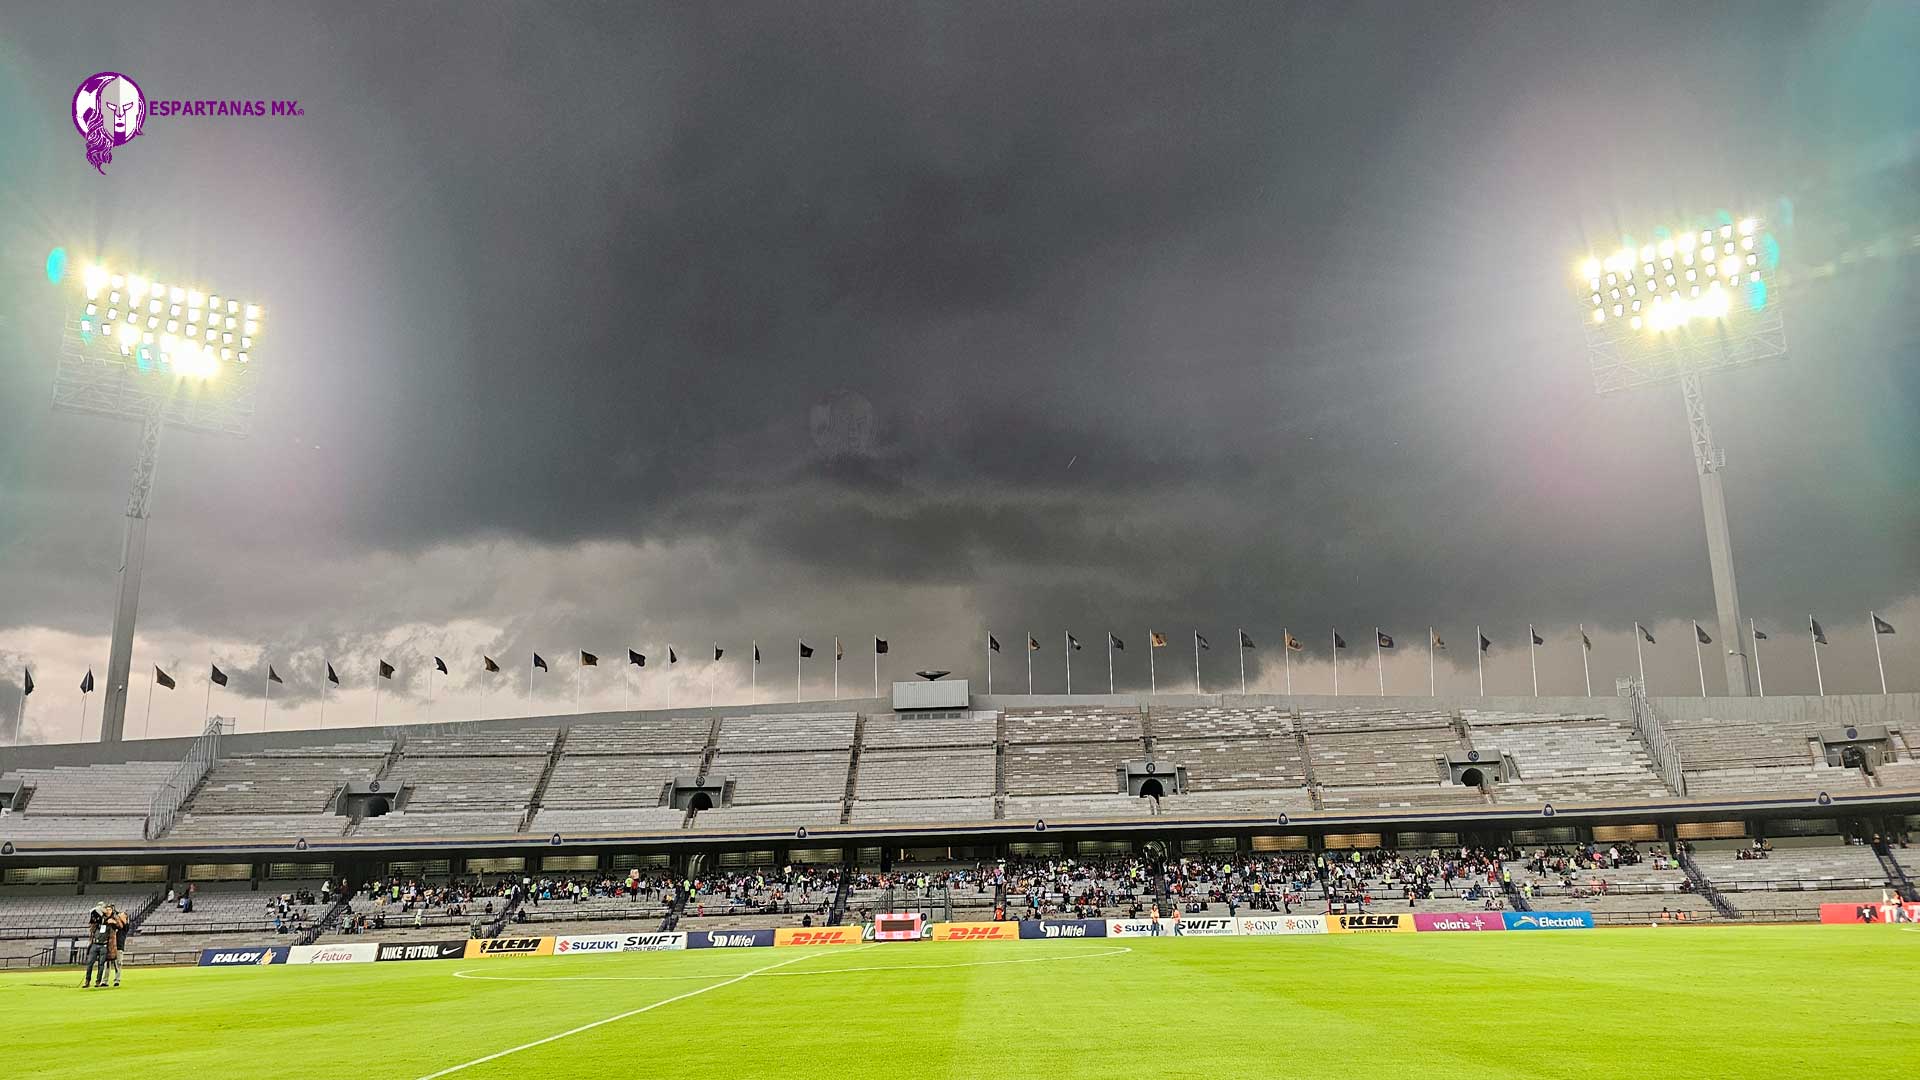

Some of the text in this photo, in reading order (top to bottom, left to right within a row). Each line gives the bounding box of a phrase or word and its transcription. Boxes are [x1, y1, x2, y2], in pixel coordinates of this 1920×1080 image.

[1178, 919, 1231, 930] SWIFT
[1254, 920, 1278, 931] GNP
[1296, 919, 1320, 930] GNP
[1348, 915, 1399, 926] KEM
[1433, 918, 1471, 930] volaris
[1539, 916, 1585, 927] Electrolit
[949, 926, 1004, 940] DHL
[1060, 924, 1088, 937] Mifel
[1124, 924, 1165, 933] SUZUI
[623, 935, 683, 947] SWIFT
[727, 934, 756, 947] Mifel
[790, 931, 847, 945] DHL
[487, 938, 542, 950] KEM
[571, 941, 619, 951] SUZUKI
[210, 952, 260, 963] RALOY
[320, 952, 353, 962] Futura
[380, 945, 439, 960] NIKE FUTBOL
